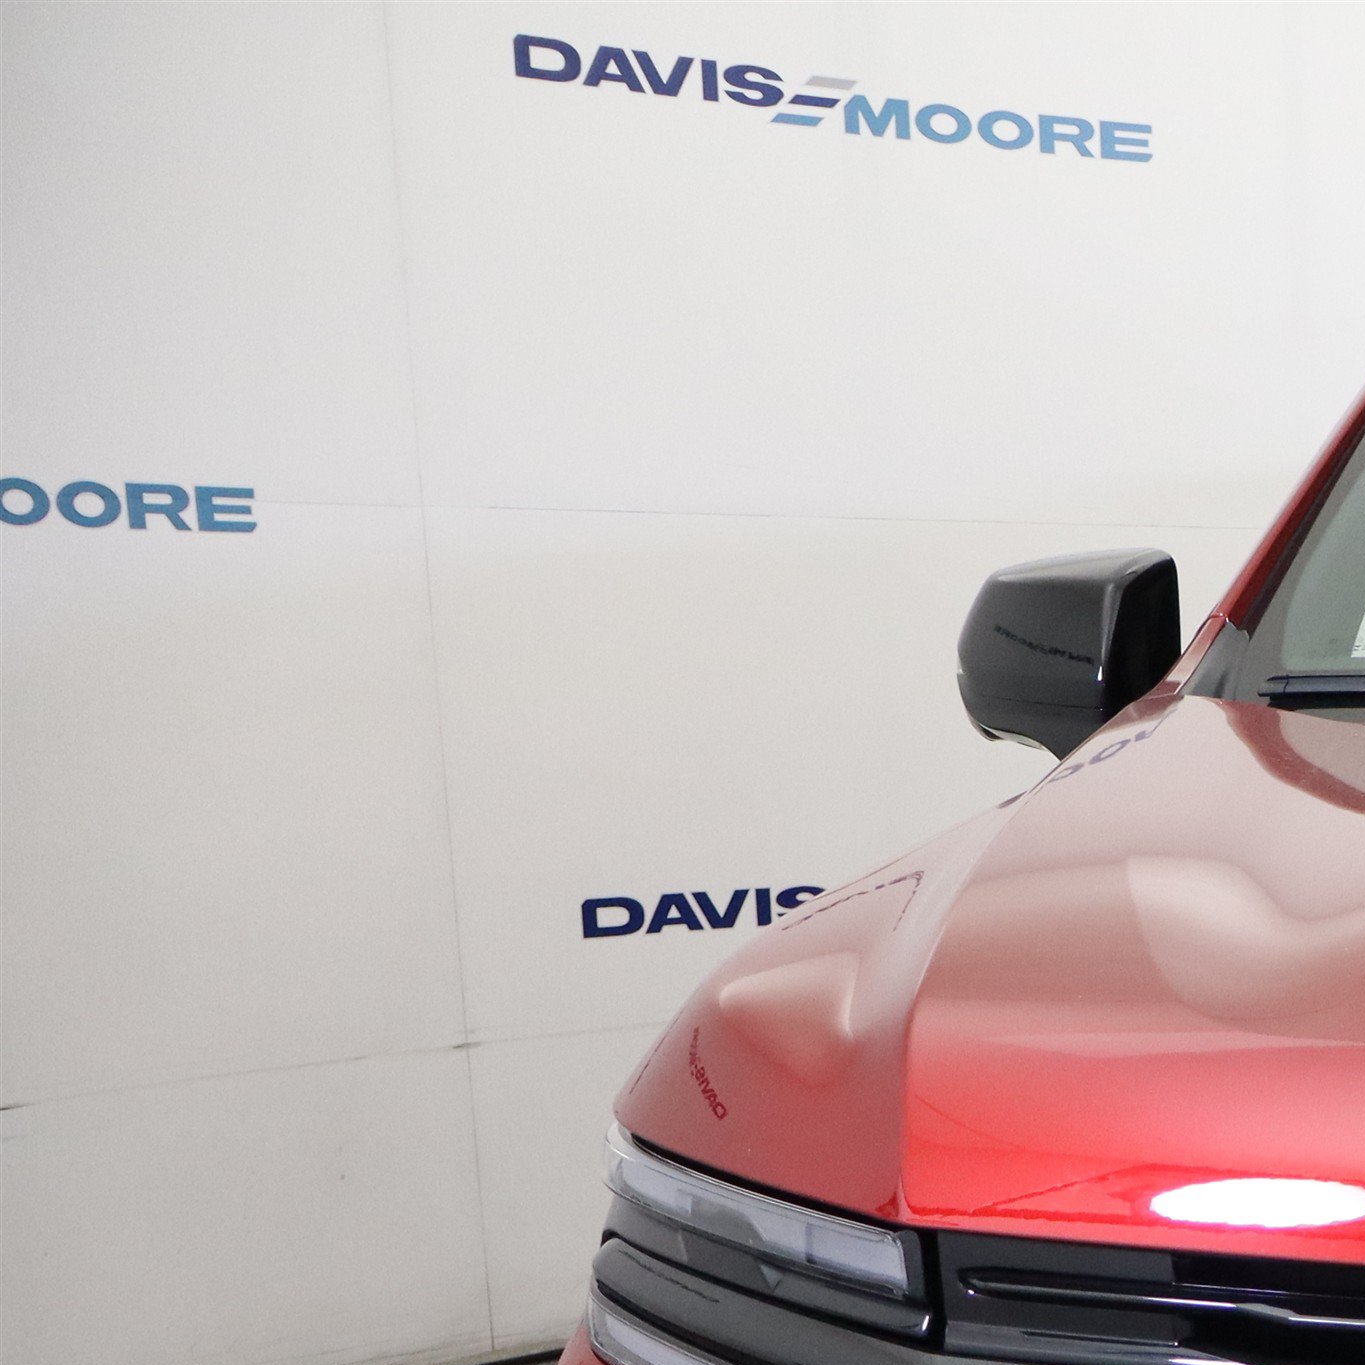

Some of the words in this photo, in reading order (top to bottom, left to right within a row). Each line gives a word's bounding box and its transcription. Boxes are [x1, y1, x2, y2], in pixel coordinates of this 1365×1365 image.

[513, 33, 784, 108] DAVIS
[844, 94, 1153, 162] MOORE
[0, 477, 257, 533] OORE
